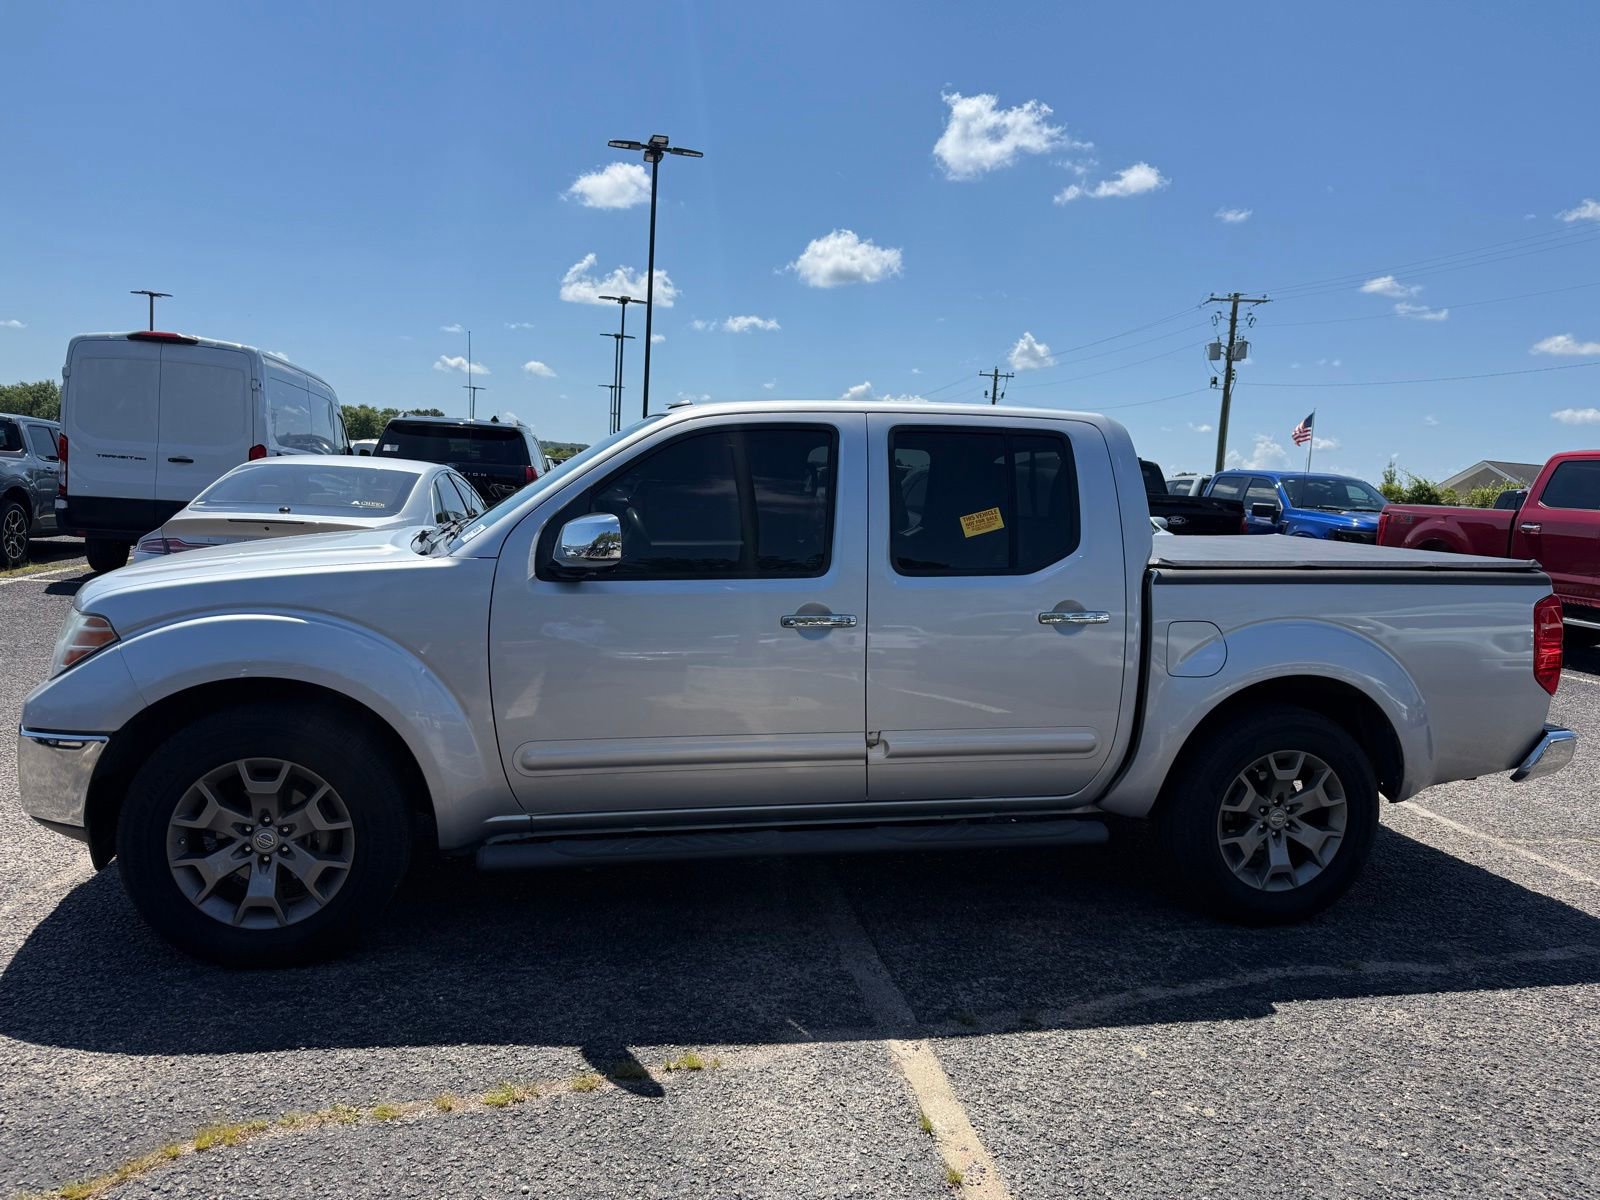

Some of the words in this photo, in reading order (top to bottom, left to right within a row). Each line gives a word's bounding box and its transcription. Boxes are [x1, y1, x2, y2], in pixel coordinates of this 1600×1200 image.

[963, 515, 976, 523] THIS
[976, 509, 999, 519] VEHICLE
[966, 520, 975, 528] NOT
[976, 517, 986, 525] FOR
[986, 514, 999, 522] SALE
